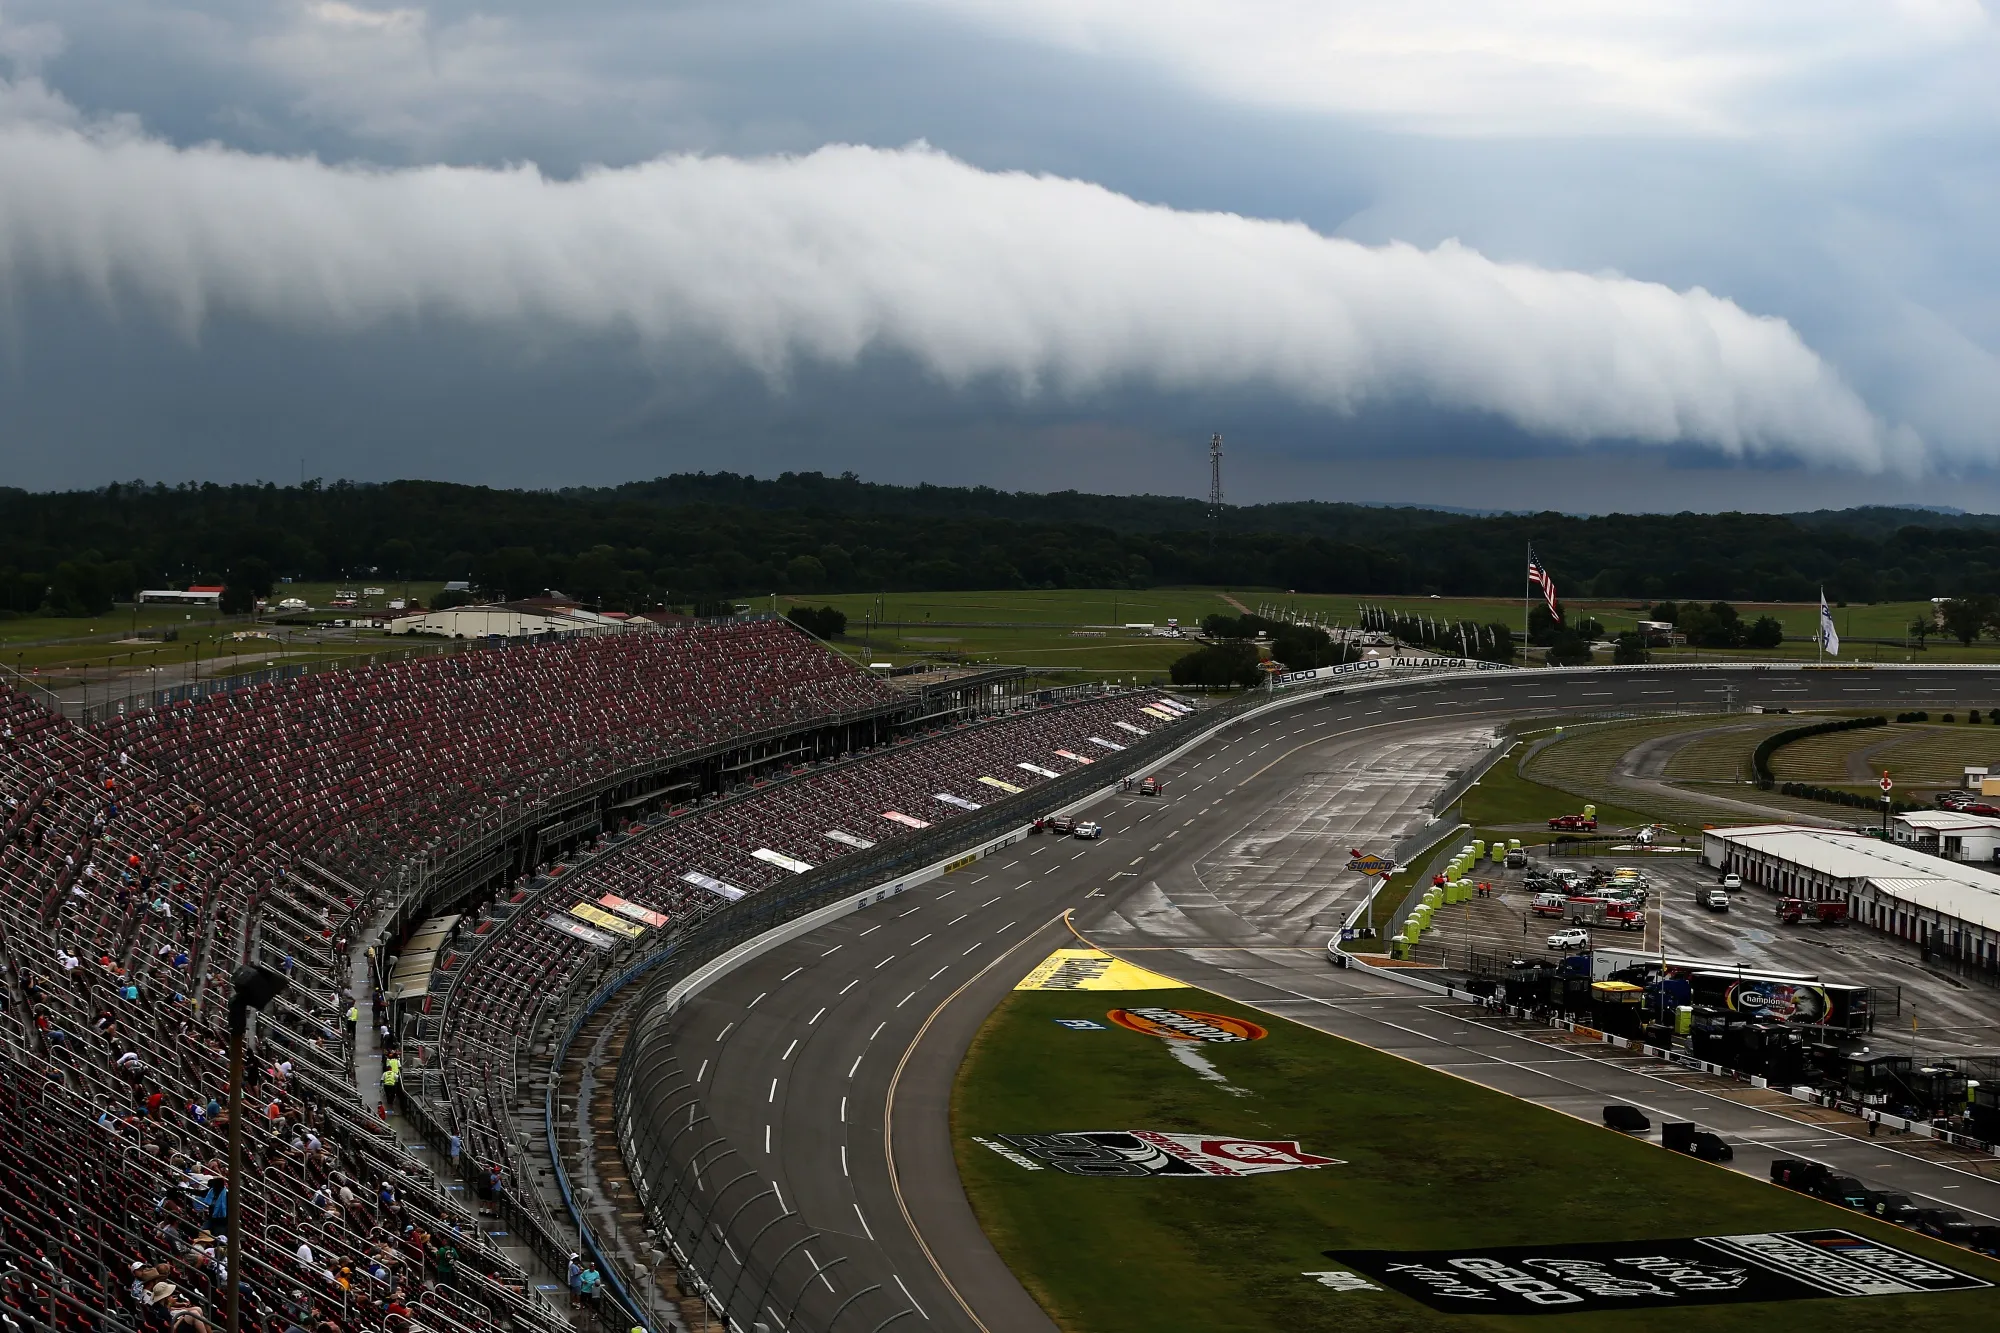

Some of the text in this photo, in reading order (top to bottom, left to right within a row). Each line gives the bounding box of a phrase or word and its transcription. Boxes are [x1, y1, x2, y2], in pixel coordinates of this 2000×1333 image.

[1332, 659, 1379, 675] GEICO
[1390, 657, 1466, 669] TALLADEGA
[1475, 661, 1519, 671] GEIC
[1271, 669, 1317, 685] GEICO
[1350, 861, 1392, 870] SUNOCO
[1738, 991, 1781, 1007] Champion
[1127, 1007, 1249, 1043] MENARDS
[980, 1141, 1045, 1171] TALLADEGA
[1613, 1256, 1740, 1290] BUSCH
[1749, 1243, 1886, 1285] CUP SERIES
[1836, 1248, 1955, 1280] NASCAR
[1301, 1271, 1384, 1292] FOX
[1386, 1262, 1498, 1300] xfinity
[1447, 1258, 1585, 1305] GEICO
